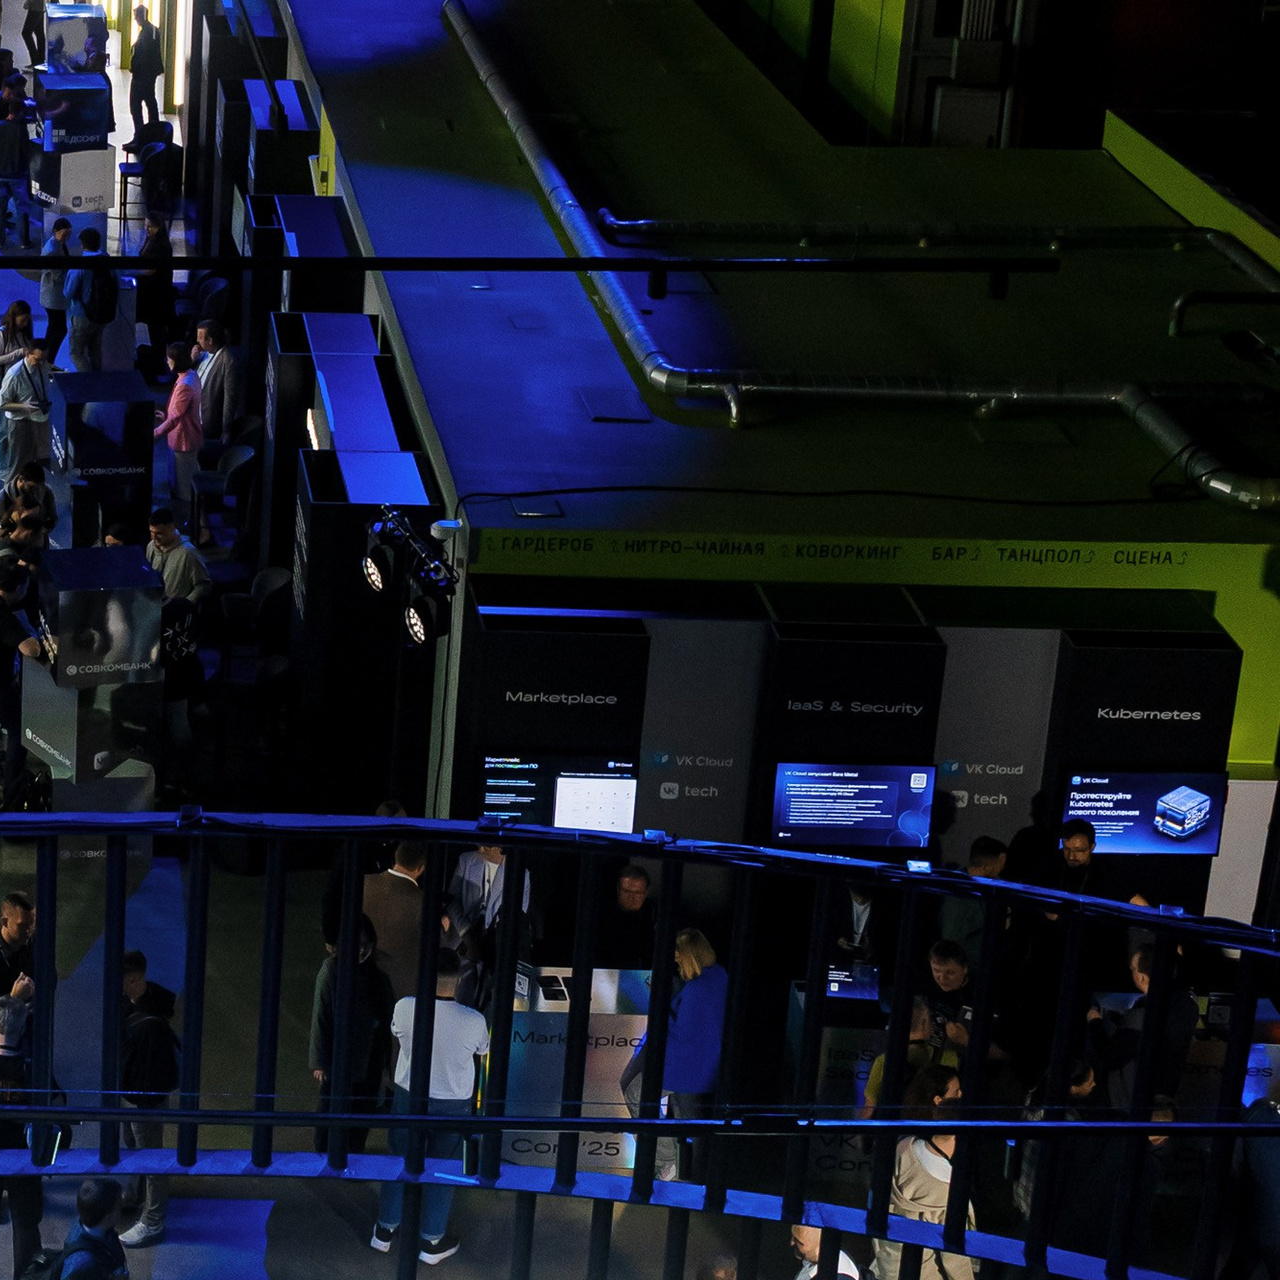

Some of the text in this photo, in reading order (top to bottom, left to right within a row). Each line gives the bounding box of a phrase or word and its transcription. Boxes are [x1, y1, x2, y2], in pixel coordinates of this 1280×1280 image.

[501, 536, 1173, 566] ГАРДЕРОБ НИТРО-ЧАЙНАЯ КОВОРКИНГ БАР ТАНЦПОЛ СЦЕНА
[78, 661, 151, 675] СОВКОМБАНК
[505, 691, 618, 706] Marketplace
[830, 701, 845, 712] &
[850, 701, 924, 717] Security
[1097, 707, 1202, 721] Kubernetes
[676, 755, 734, 767] VK Cloud
[965, 763, 1024, 775] VK Cloud
[684, 786, 719, 797] tech
[1070, 792, 1132, 801] Протестируйте
[973, 793, 1008, 806] tech
[1069, 800, 1114, 808] Kubernetes
[1097, 809, 1140, 817] поколения
